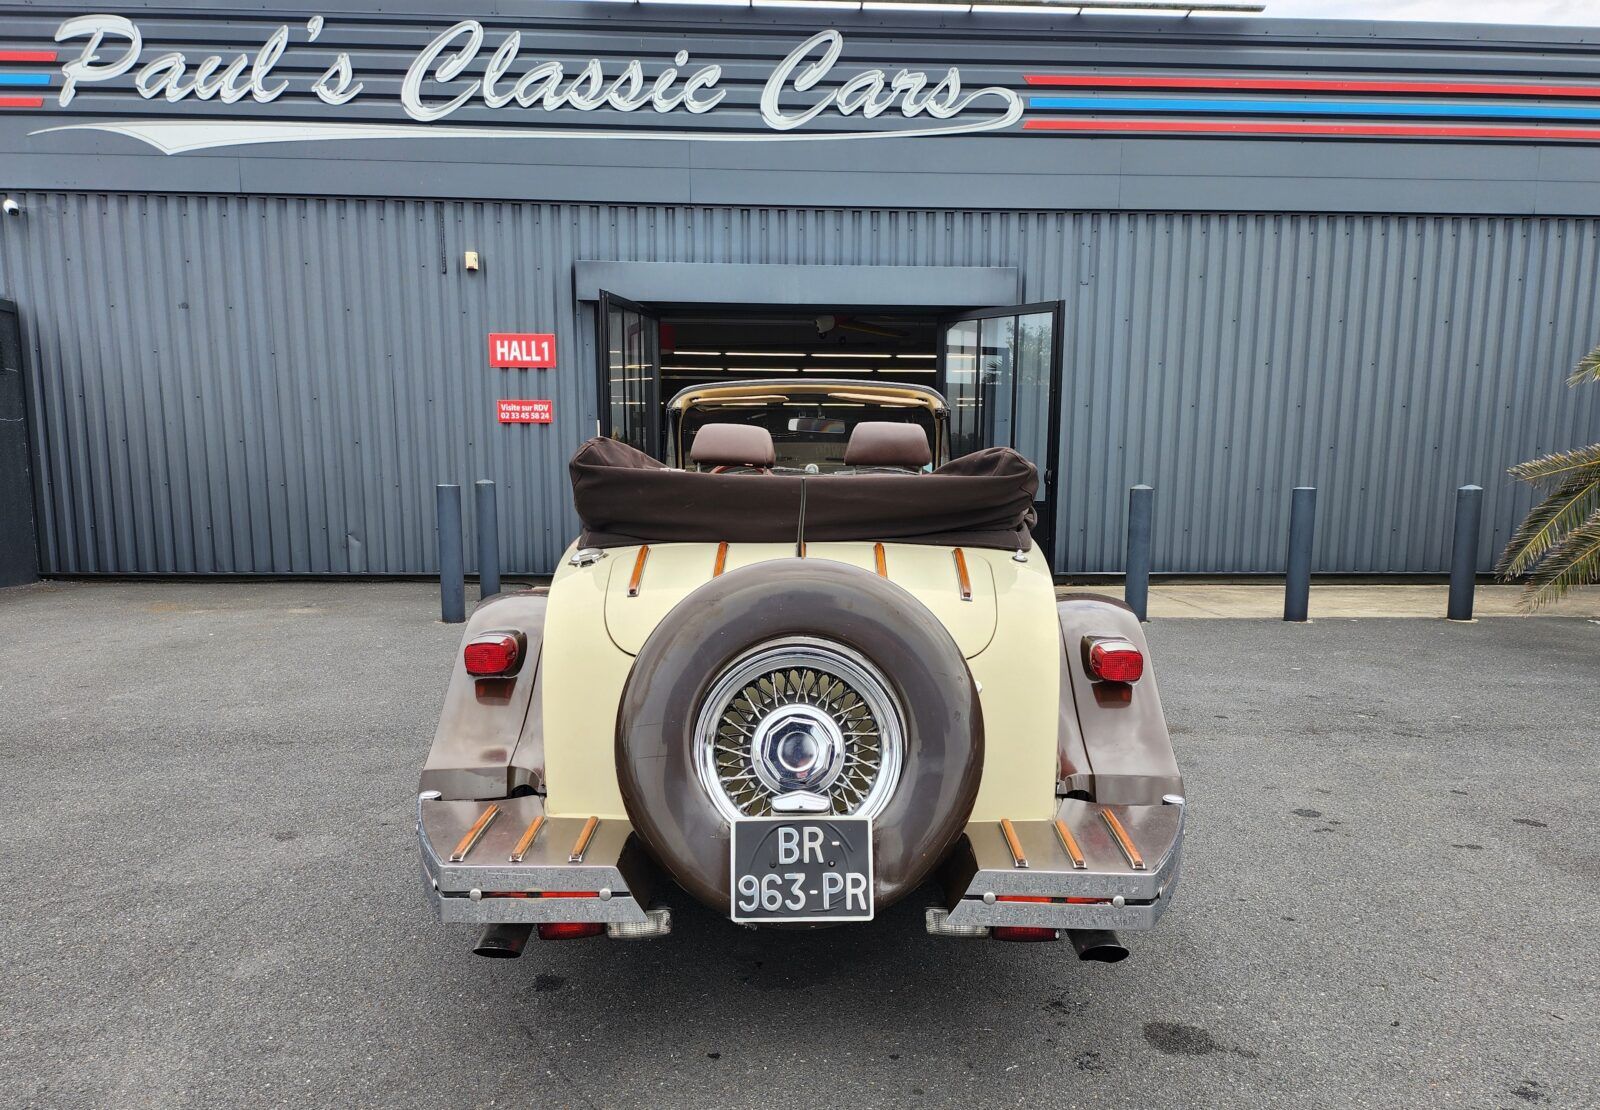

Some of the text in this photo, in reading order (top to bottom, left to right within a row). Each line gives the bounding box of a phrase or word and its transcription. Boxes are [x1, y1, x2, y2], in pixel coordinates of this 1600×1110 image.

[54, 15, 1024, 131] Paul's Classic Cars
[738, 872, 867, 912] 963-PR
